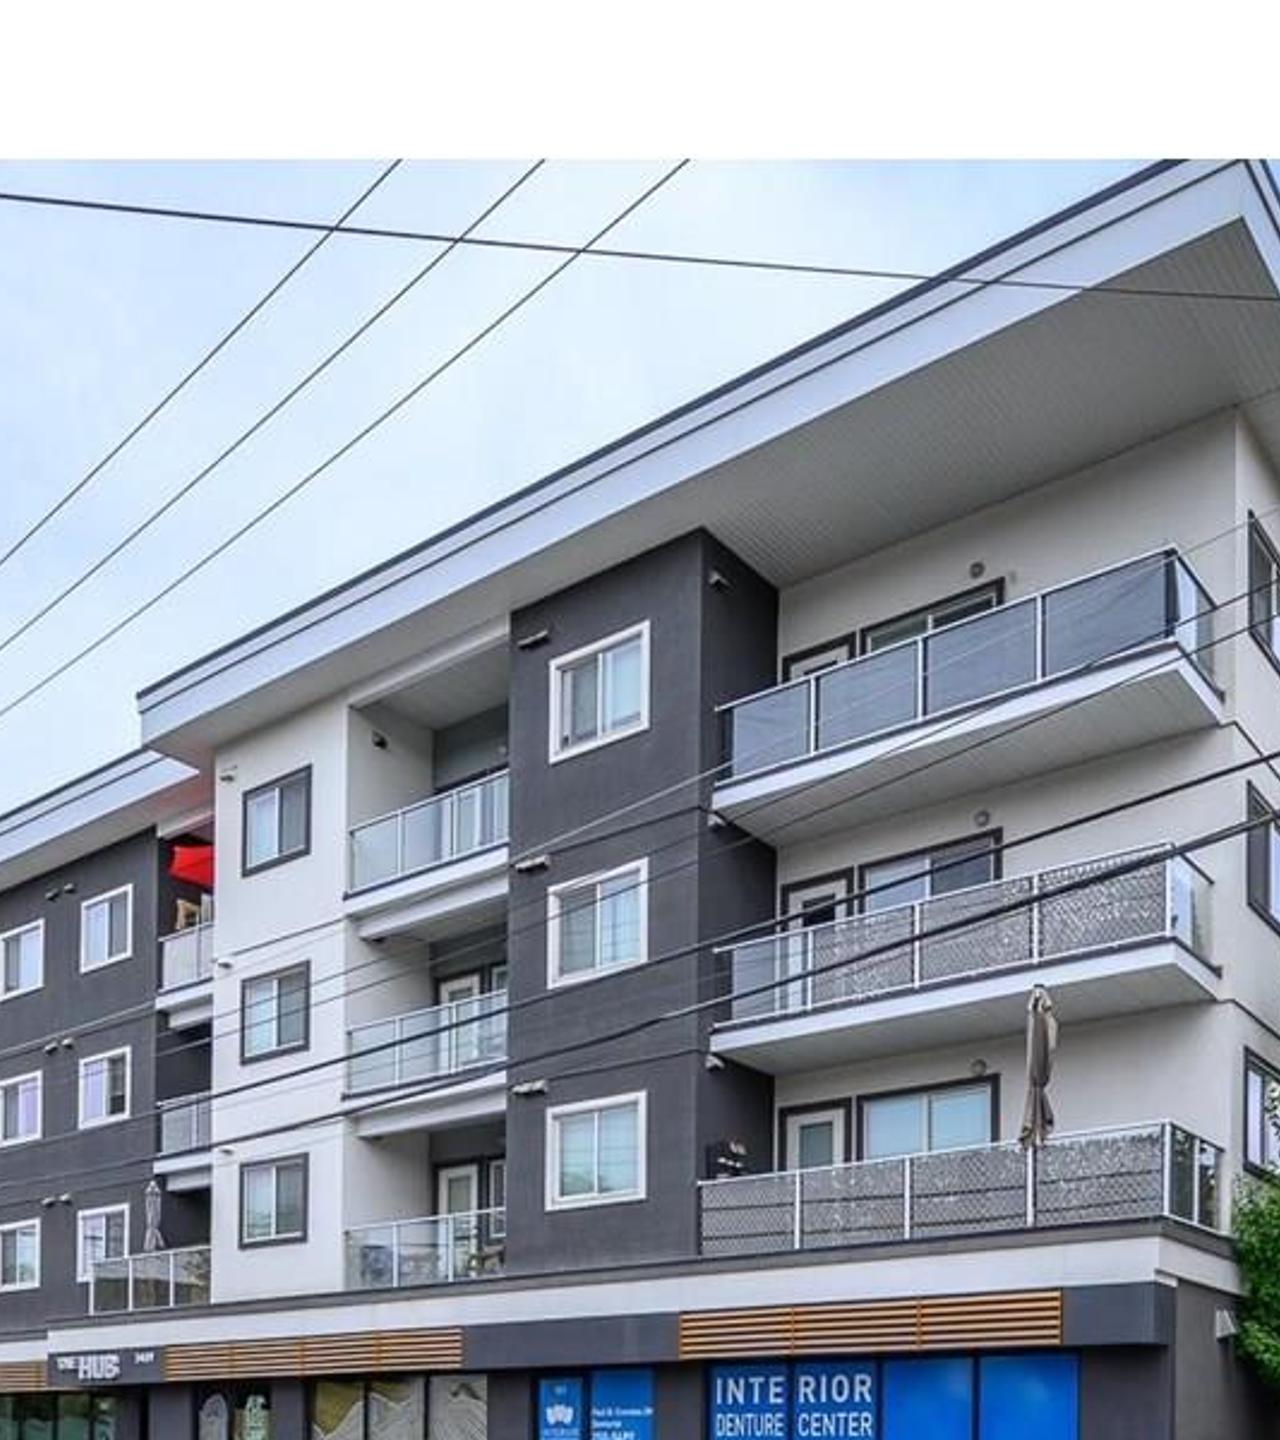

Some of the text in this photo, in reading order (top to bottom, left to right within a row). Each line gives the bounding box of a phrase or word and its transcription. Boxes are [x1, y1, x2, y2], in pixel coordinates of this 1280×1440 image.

[78, 1354, 120, 1380] HUB
[715, 1411, 873, 1438] DENTURE CENTER
